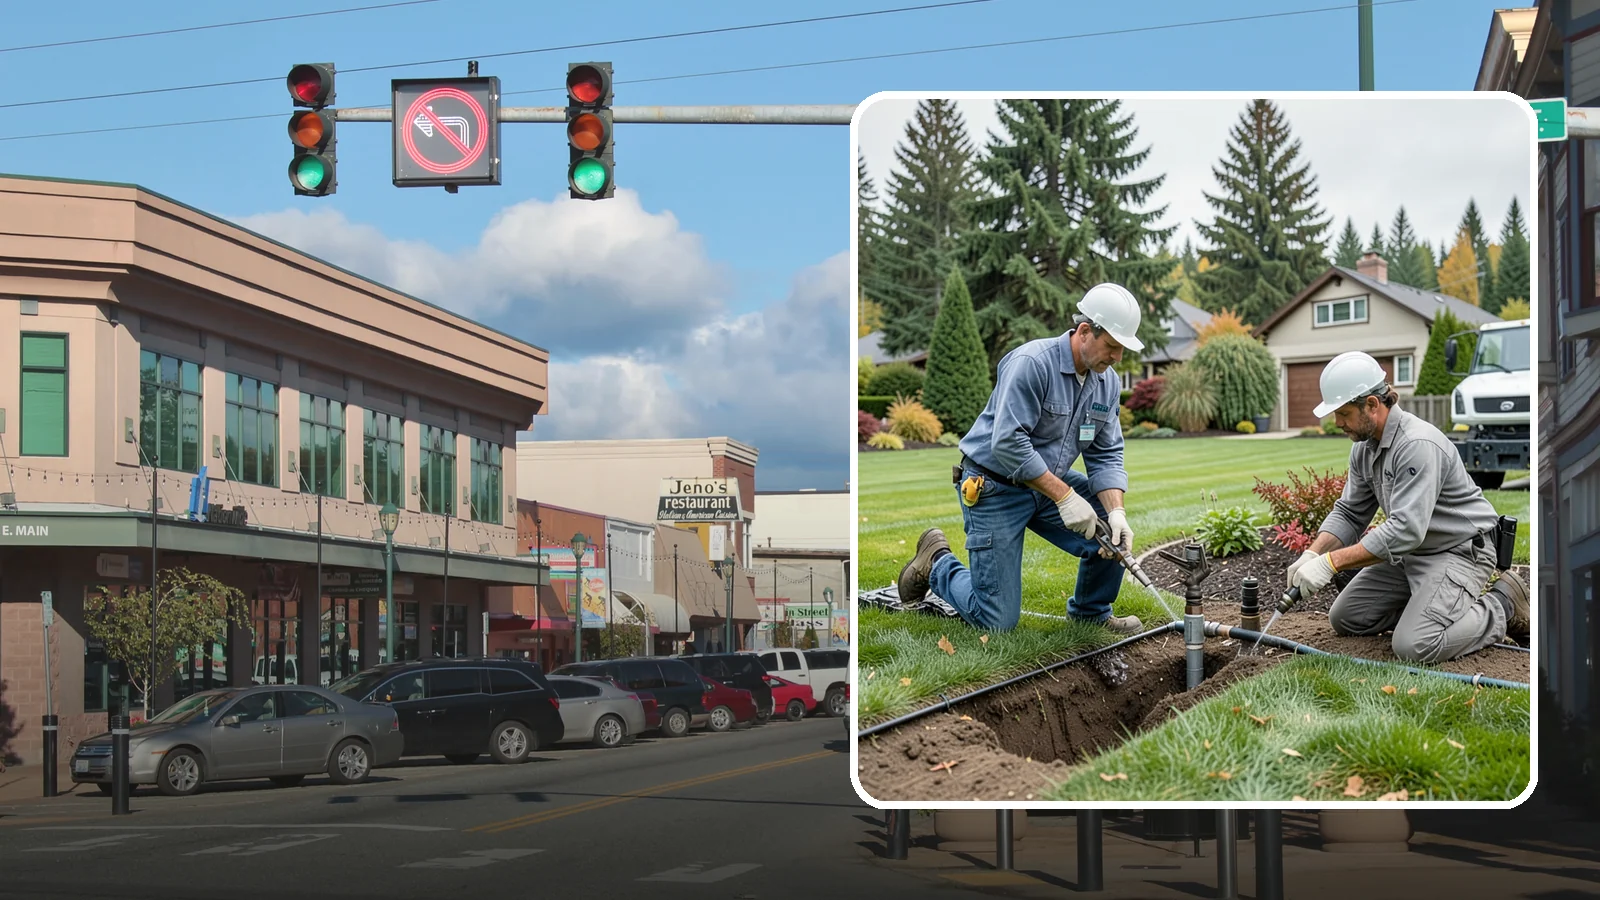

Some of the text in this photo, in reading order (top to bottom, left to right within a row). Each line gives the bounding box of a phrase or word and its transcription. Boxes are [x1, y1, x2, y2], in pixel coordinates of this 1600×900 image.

[670, 480, 728, 494] Jeno's
[664, 496, 731, 509] restaurant
[658, 510, 682, 520] Italian
[686, 509, 715, 520] American
[715, 509, 738, 520] Cuisine
[2, 525, 49, 536] E. MAIN
[797, 607, 829, 617] Street
